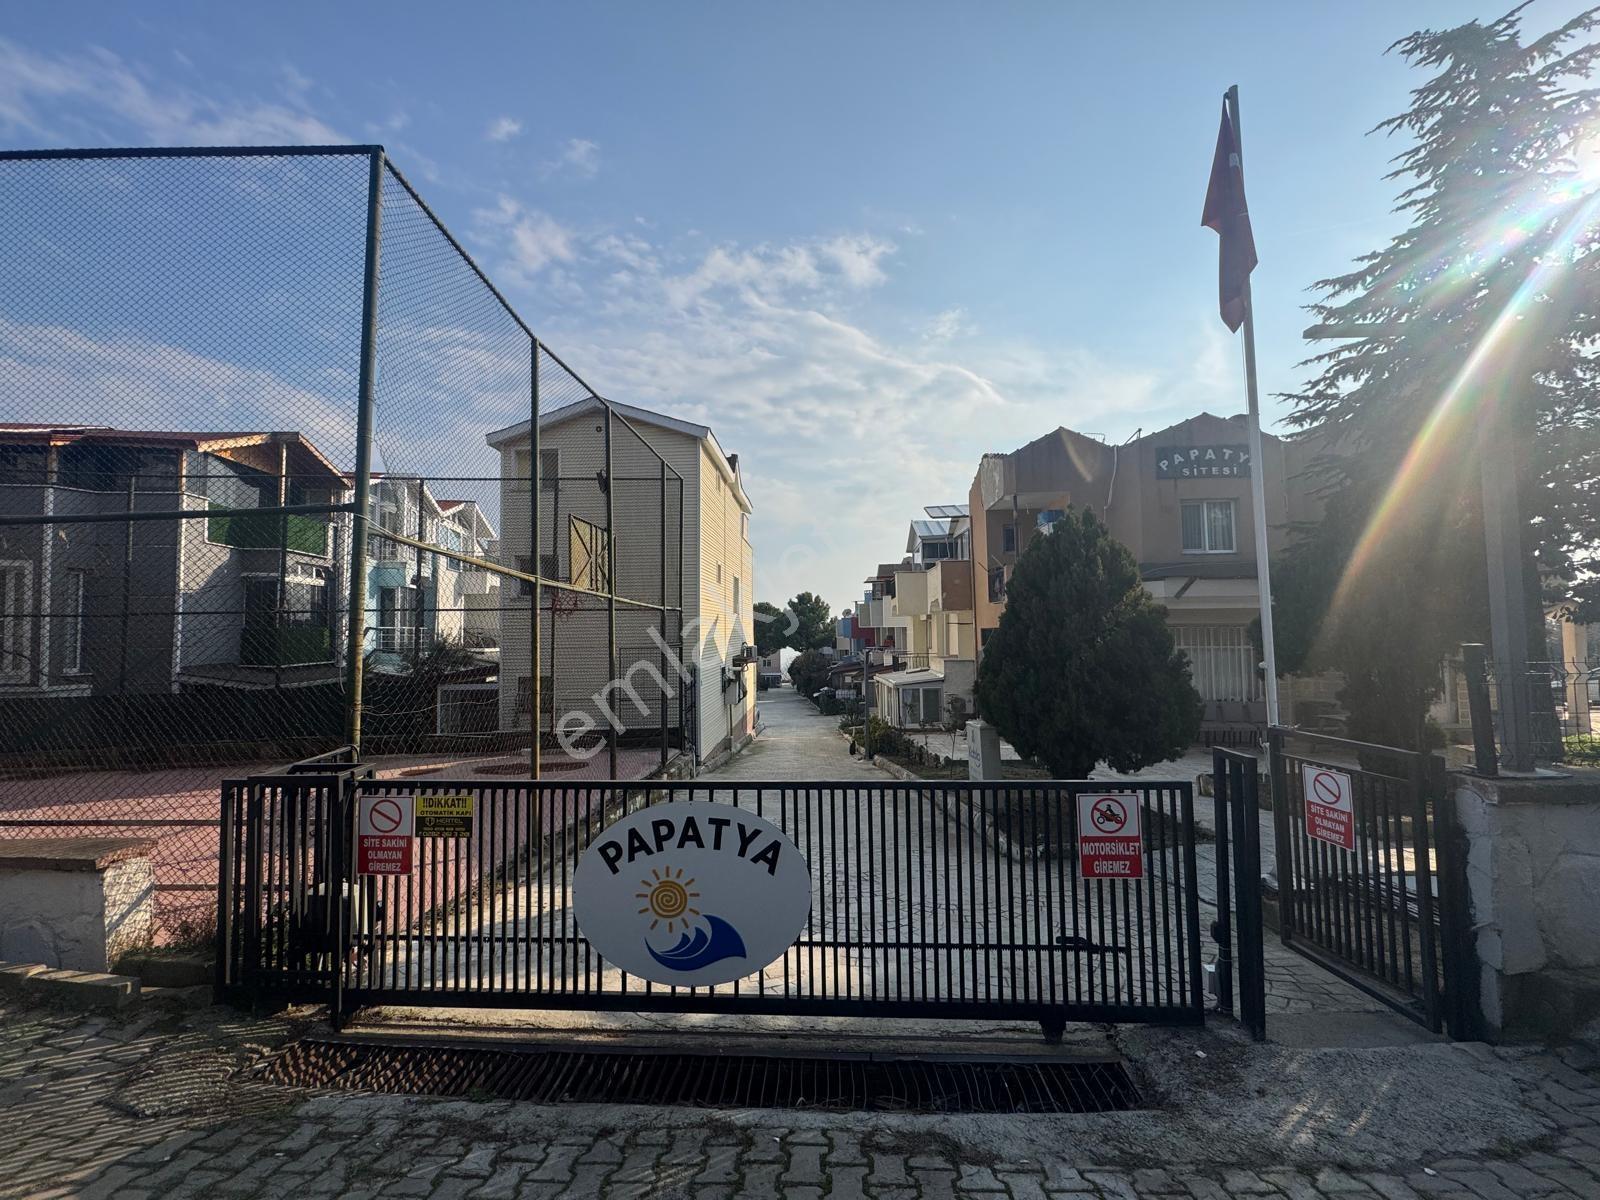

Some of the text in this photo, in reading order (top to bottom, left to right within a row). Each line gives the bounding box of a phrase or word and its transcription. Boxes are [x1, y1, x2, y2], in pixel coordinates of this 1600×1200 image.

[1159, 449, 1252, 471] PAPATY
[1182, 464, 1237, 476] SİTESİ
[1311, 804, 1348, 823] SİTE SAKİNİ
[1315, 817, 1345, 832] OLMAYAN
[363, 837, 407, 847] SİTE SAKİNİ
[1316, 827, 1344, 843] GİREMEZ
[597, 816, 782, 876] PAPATYA
[1082, 840, 1139, 855] MOTORSİKLET
[367, 850, 402, 859] OLMAYAN
[368, 861, 401, 871] GİREMEZ
[1094, 858, 1131, 874] GİREMEZ
